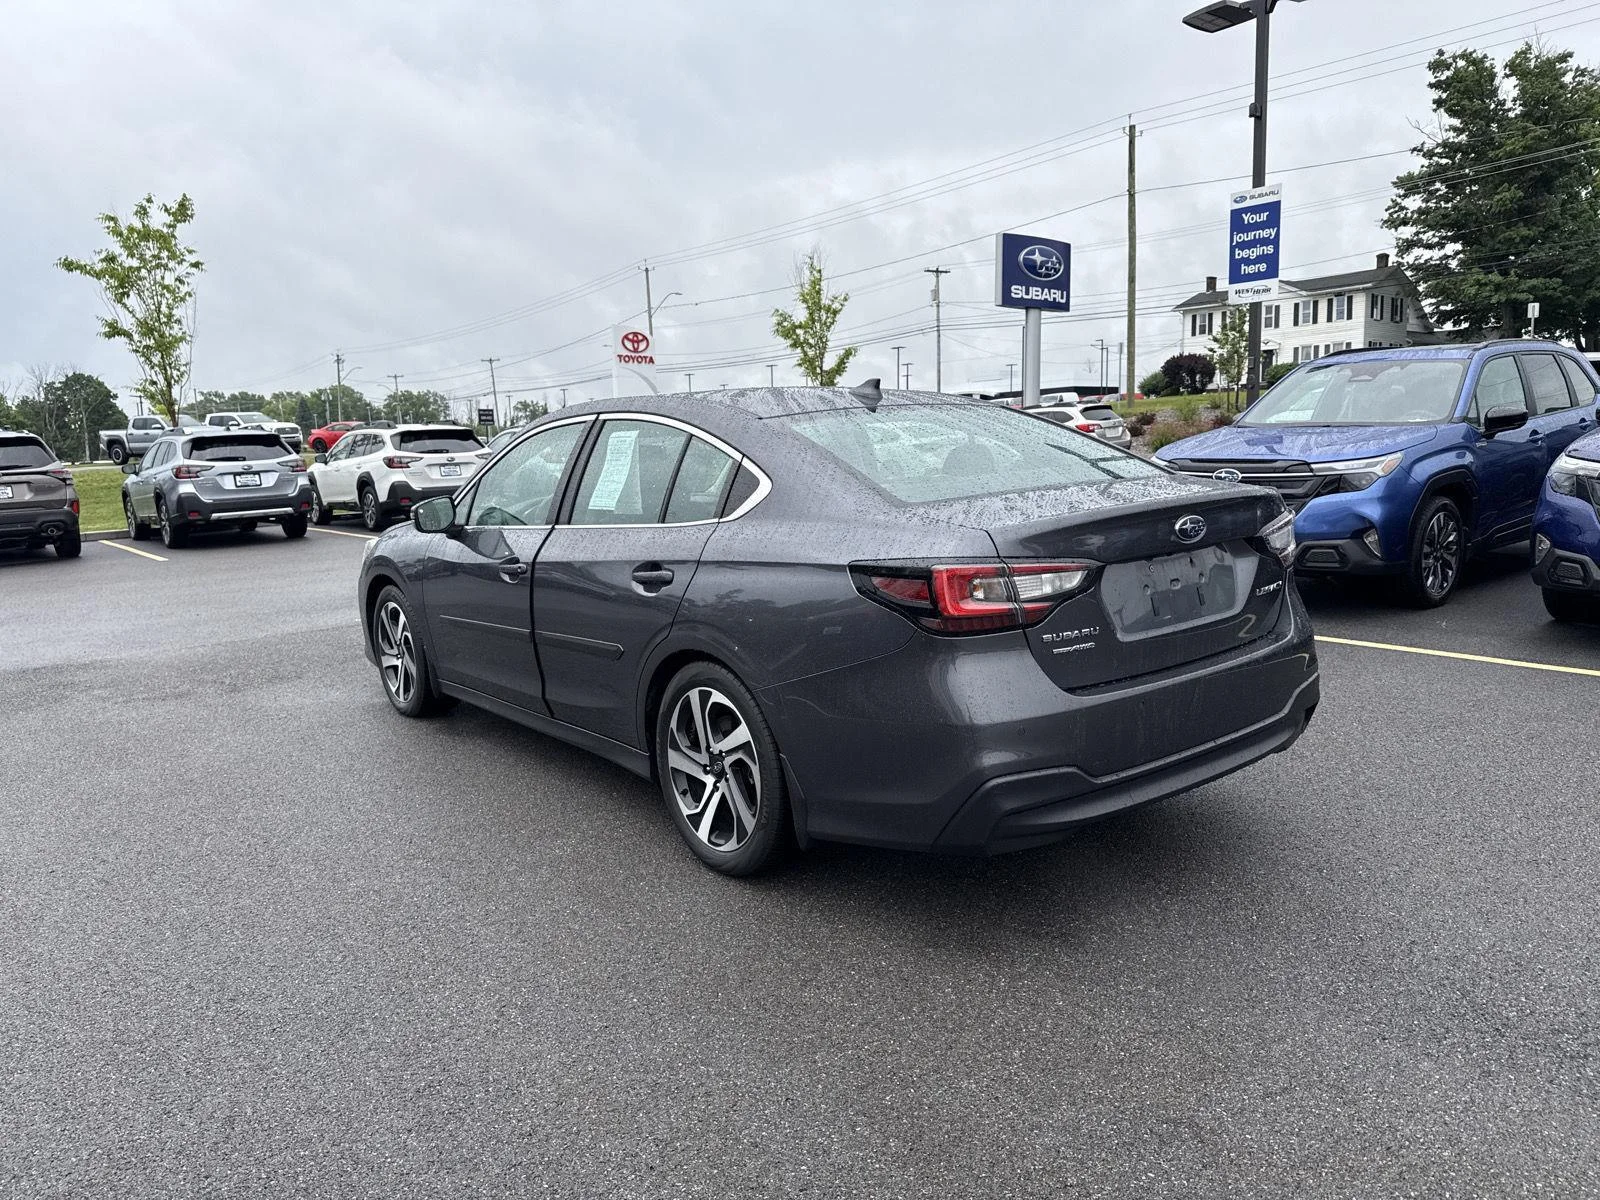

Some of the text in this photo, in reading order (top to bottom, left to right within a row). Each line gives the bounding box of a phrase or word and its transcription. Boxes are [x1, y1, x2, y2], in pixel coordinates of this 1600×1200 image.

[1249, 189, 1279, 200] SUBARU
[1242, 211, 1269, 225] Your
[1232, 228, 1277, 245] journey
[1235, 244, 1274, 259] begins
[1240, 262, 1267, 275] here
[1011, 285, 1066, 303] SUBARU
[617, 354, 655, 364] TOYOTA
[1042, 626, 1100, 643] SUBARU
